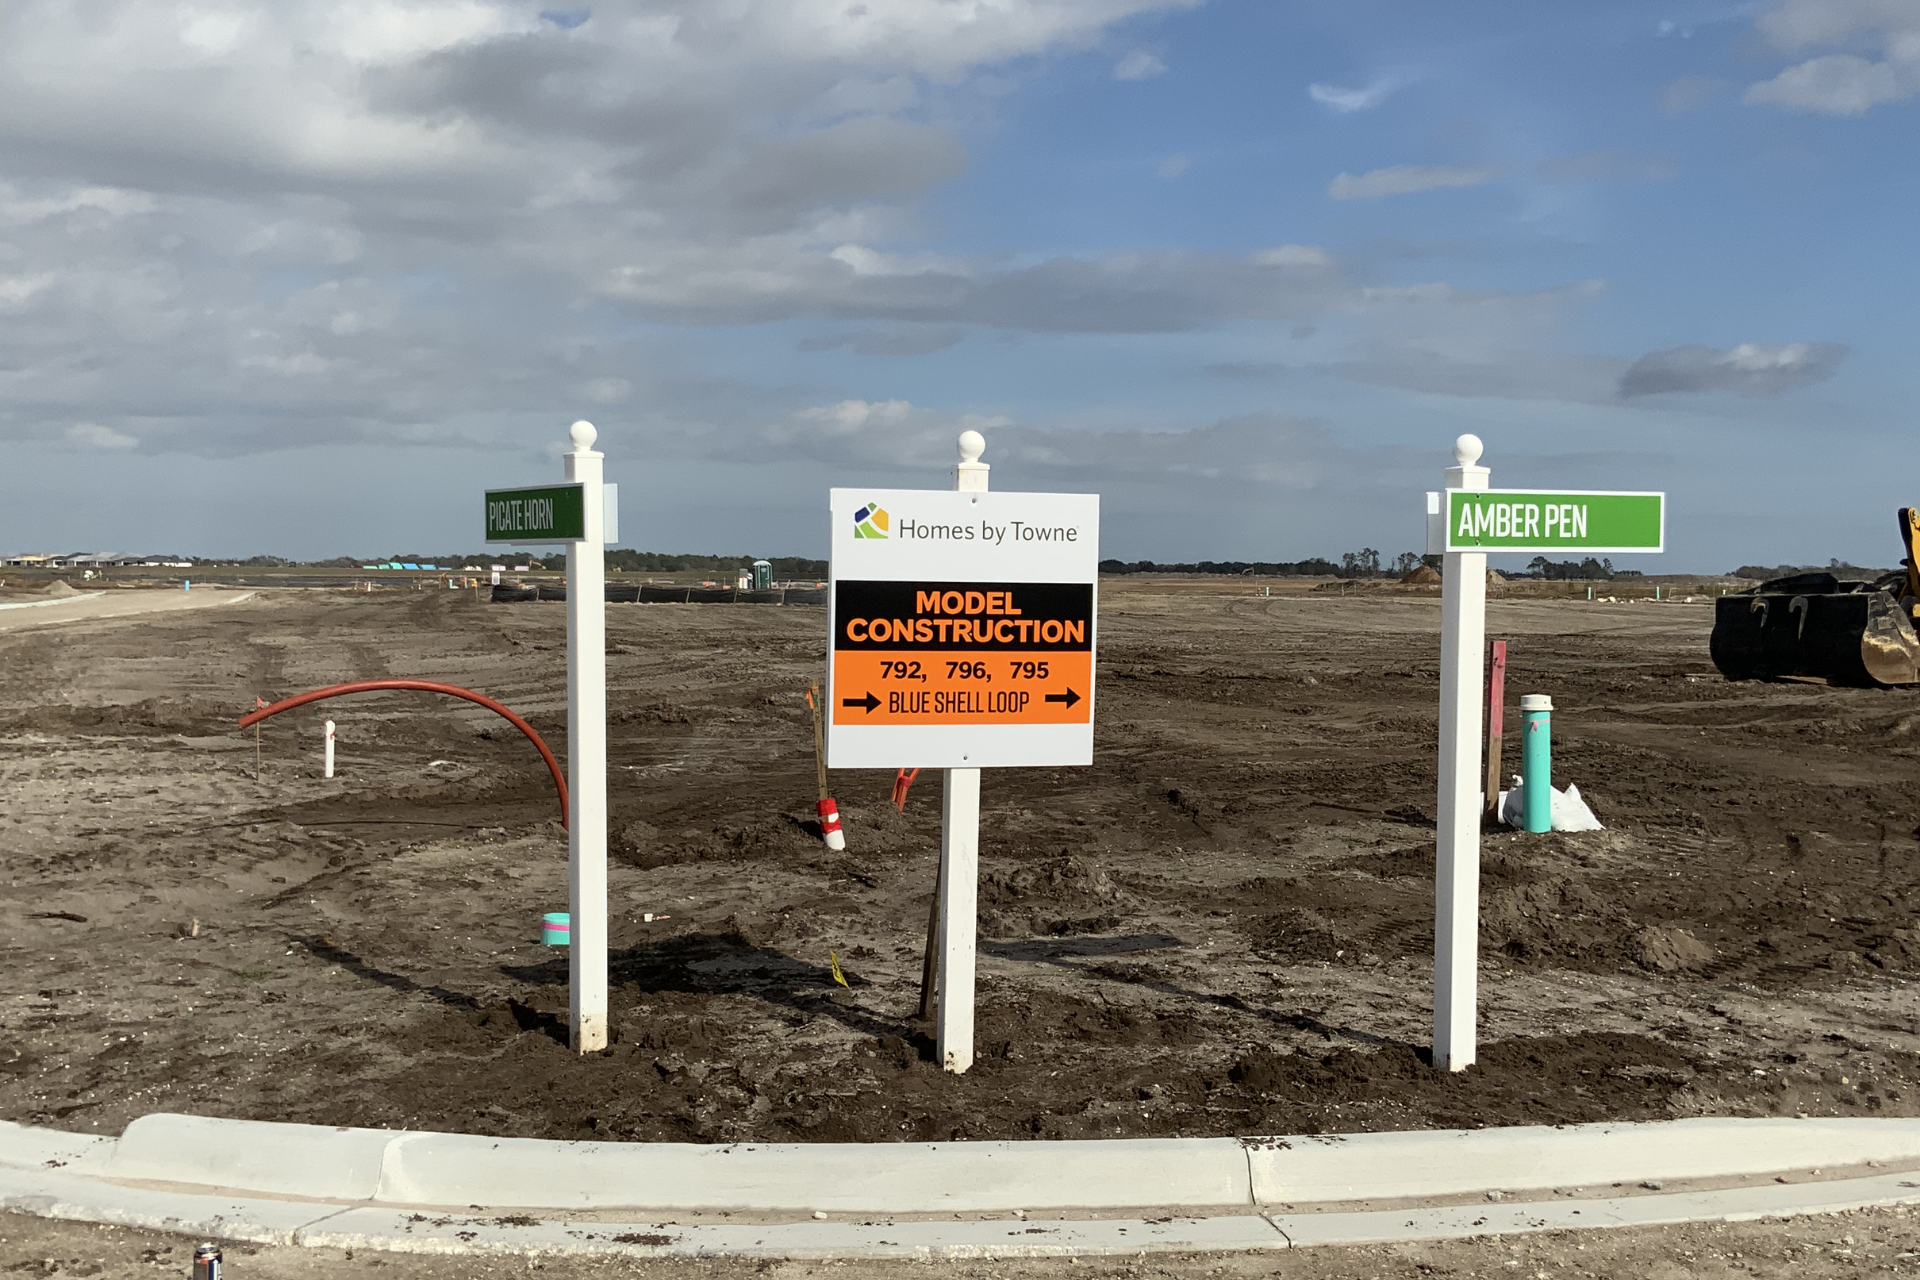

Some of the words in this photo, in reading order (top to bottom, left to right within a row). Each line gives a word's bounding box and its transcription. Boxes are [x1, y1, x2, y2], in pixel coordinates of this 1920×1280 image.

[489, 500, 523, 531] PICATE
[524, 498, 554, 530] HORN
[1457, 503, 1540, 538] AMBER
[1544, 504, 1588, 538] PEN
[900, 519, 975, 541] Homes
[982, 520, 1006, 546] by
[1010, 521, 1078, 542] Towne
[916, 590, 1022, 615] MODEL
[846, 618, 1085, 643] CONSTRUCTION
[880, 661, 927, 683] 792,
[946, 661, 992, 683] 796,
[1010, 661, 1049, 679] 795
[889, 692, 930, 713] BLUE
[934, 692, 984, 713] SHELL
[988, 692, 1030, 713] LOOP
